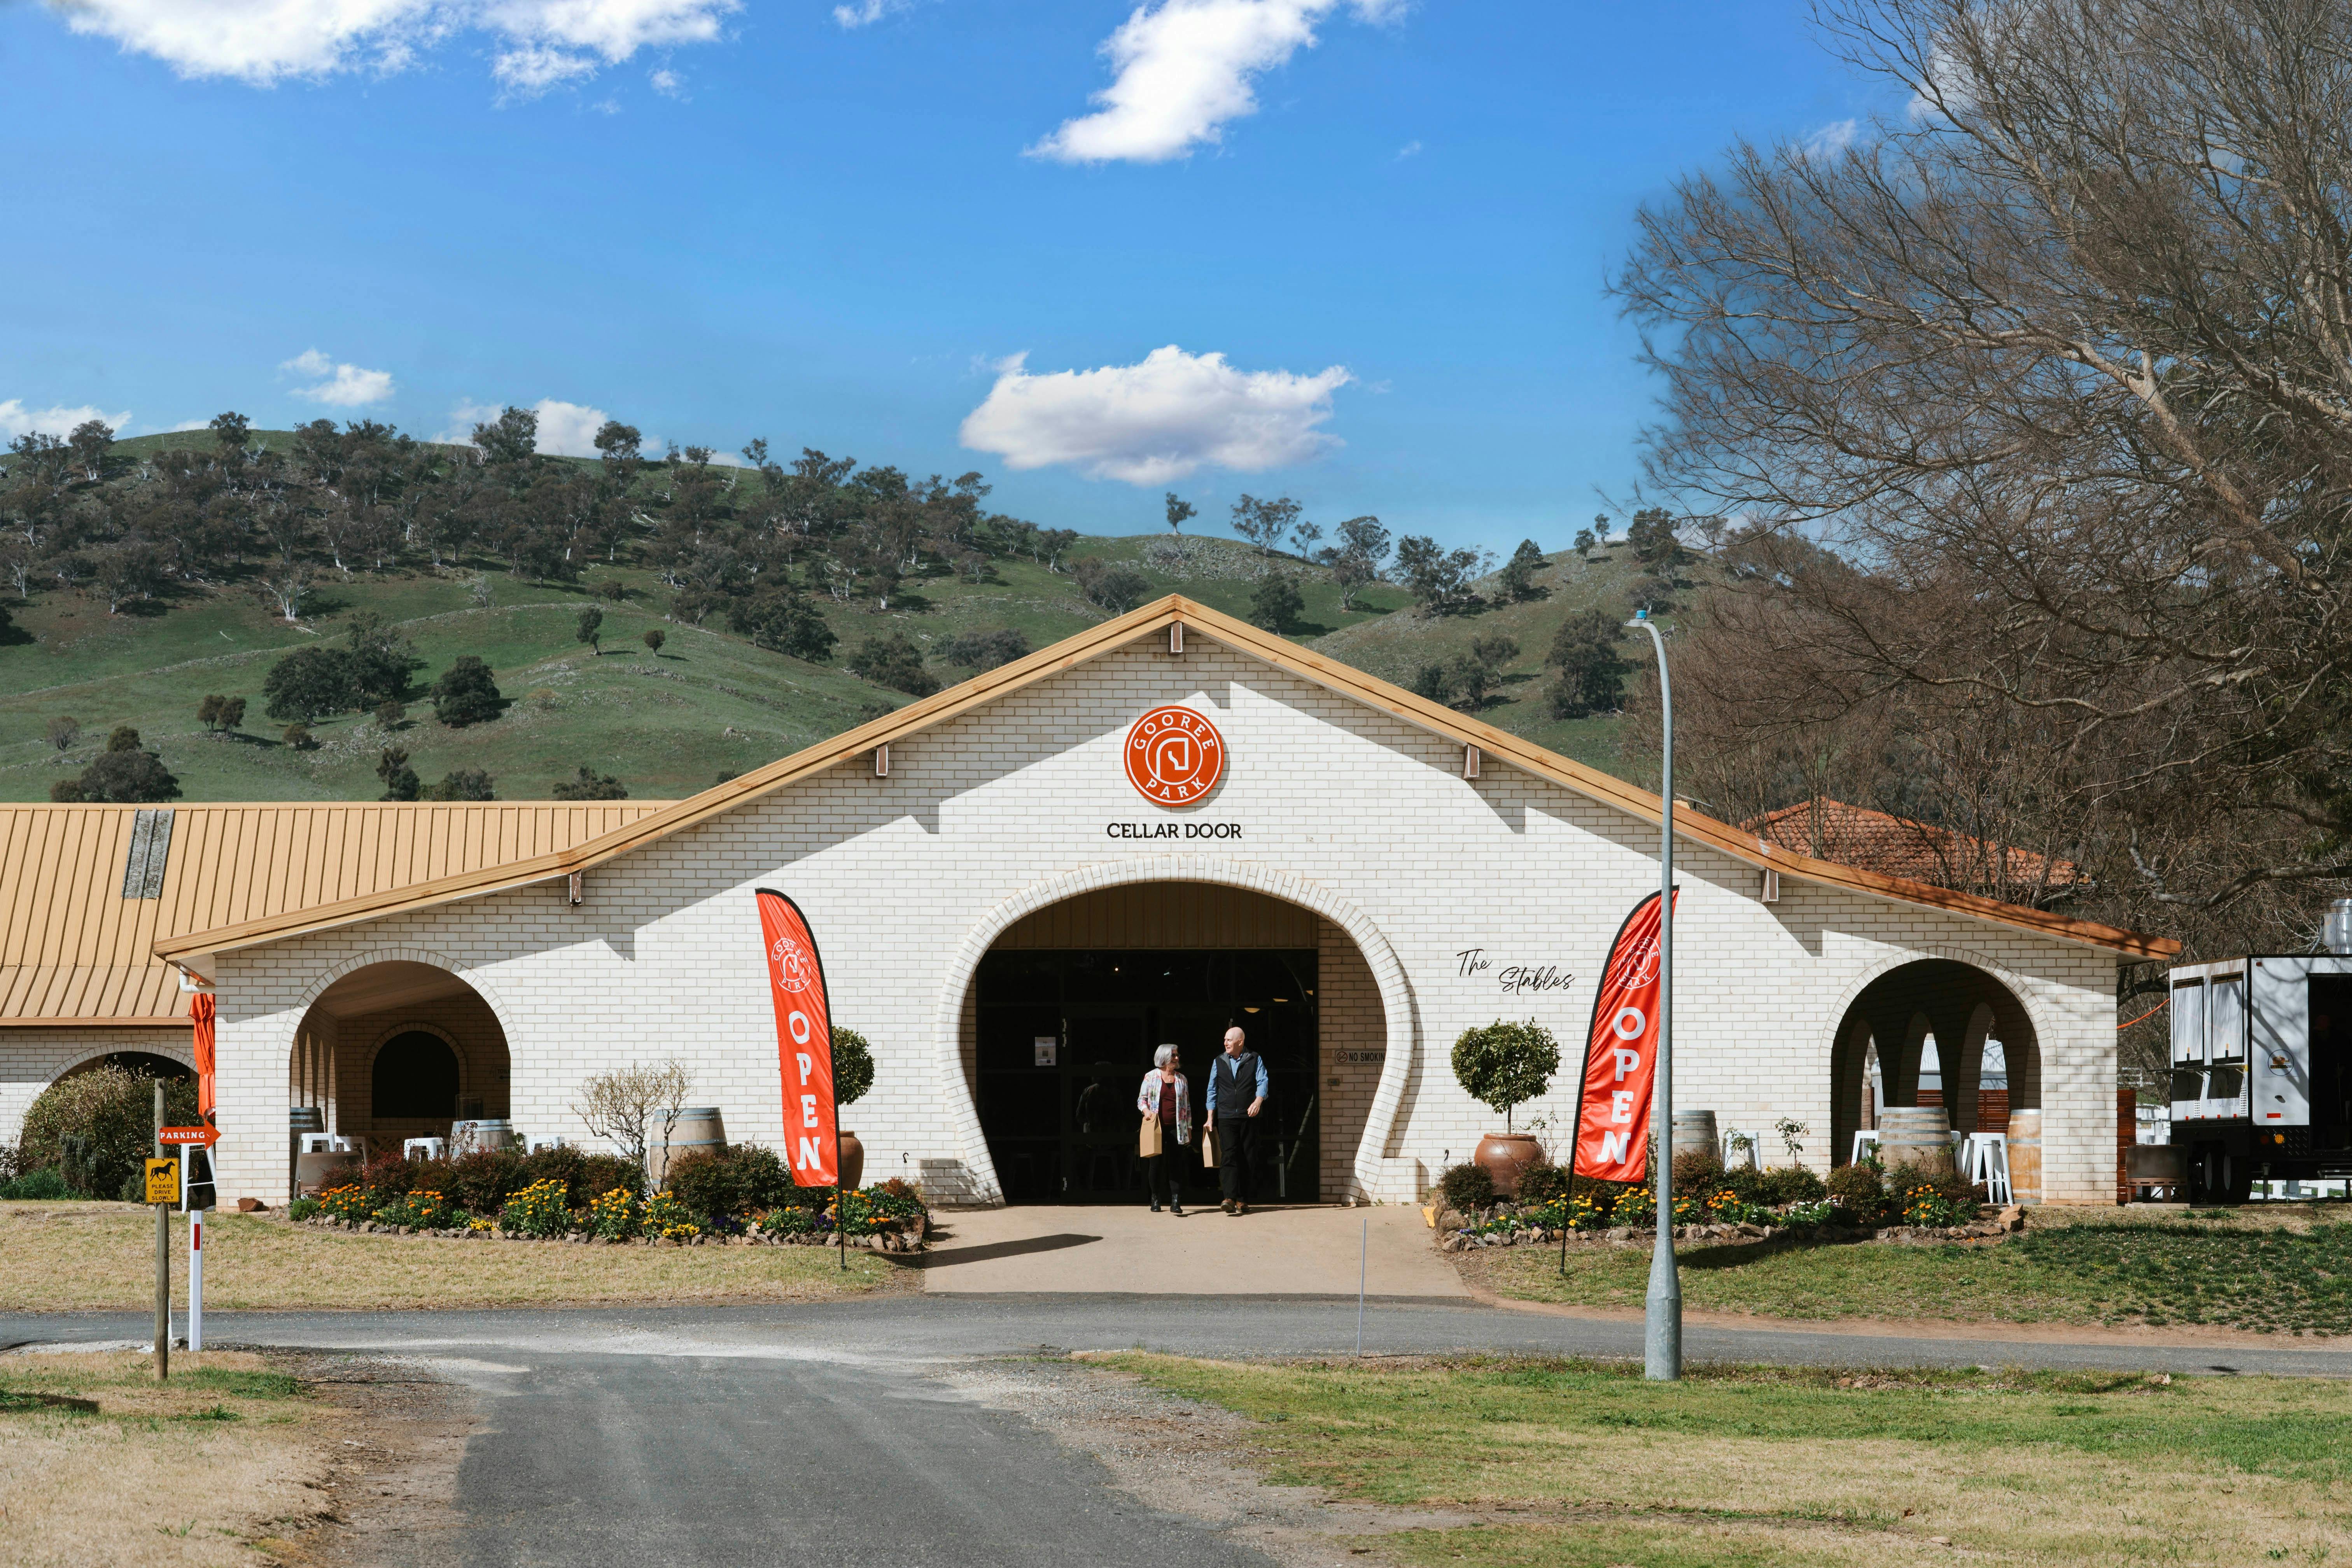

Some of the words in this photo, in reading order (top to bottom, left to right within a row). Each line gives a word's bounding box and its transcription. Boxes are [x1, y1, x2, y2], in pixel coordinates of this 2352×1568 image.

[1134, 714, 1214, 750] GOOREE
[1146, 776, 1205, 798] PARK
[1107, 822, 1179, 838] CELLAR
[1185, 823, 1242, 839] DOOR
[1456, 948, 1493, 977] The
[1498, 966, 1575, 996] Stables
[1349, 1052, 1358, 1061] NO
[1360, 1052, 1385, 1061] SMOKIN
[788, 1010, 821, 1170] OPEN
[1596, 1006, 1646, 1165] OPEN
